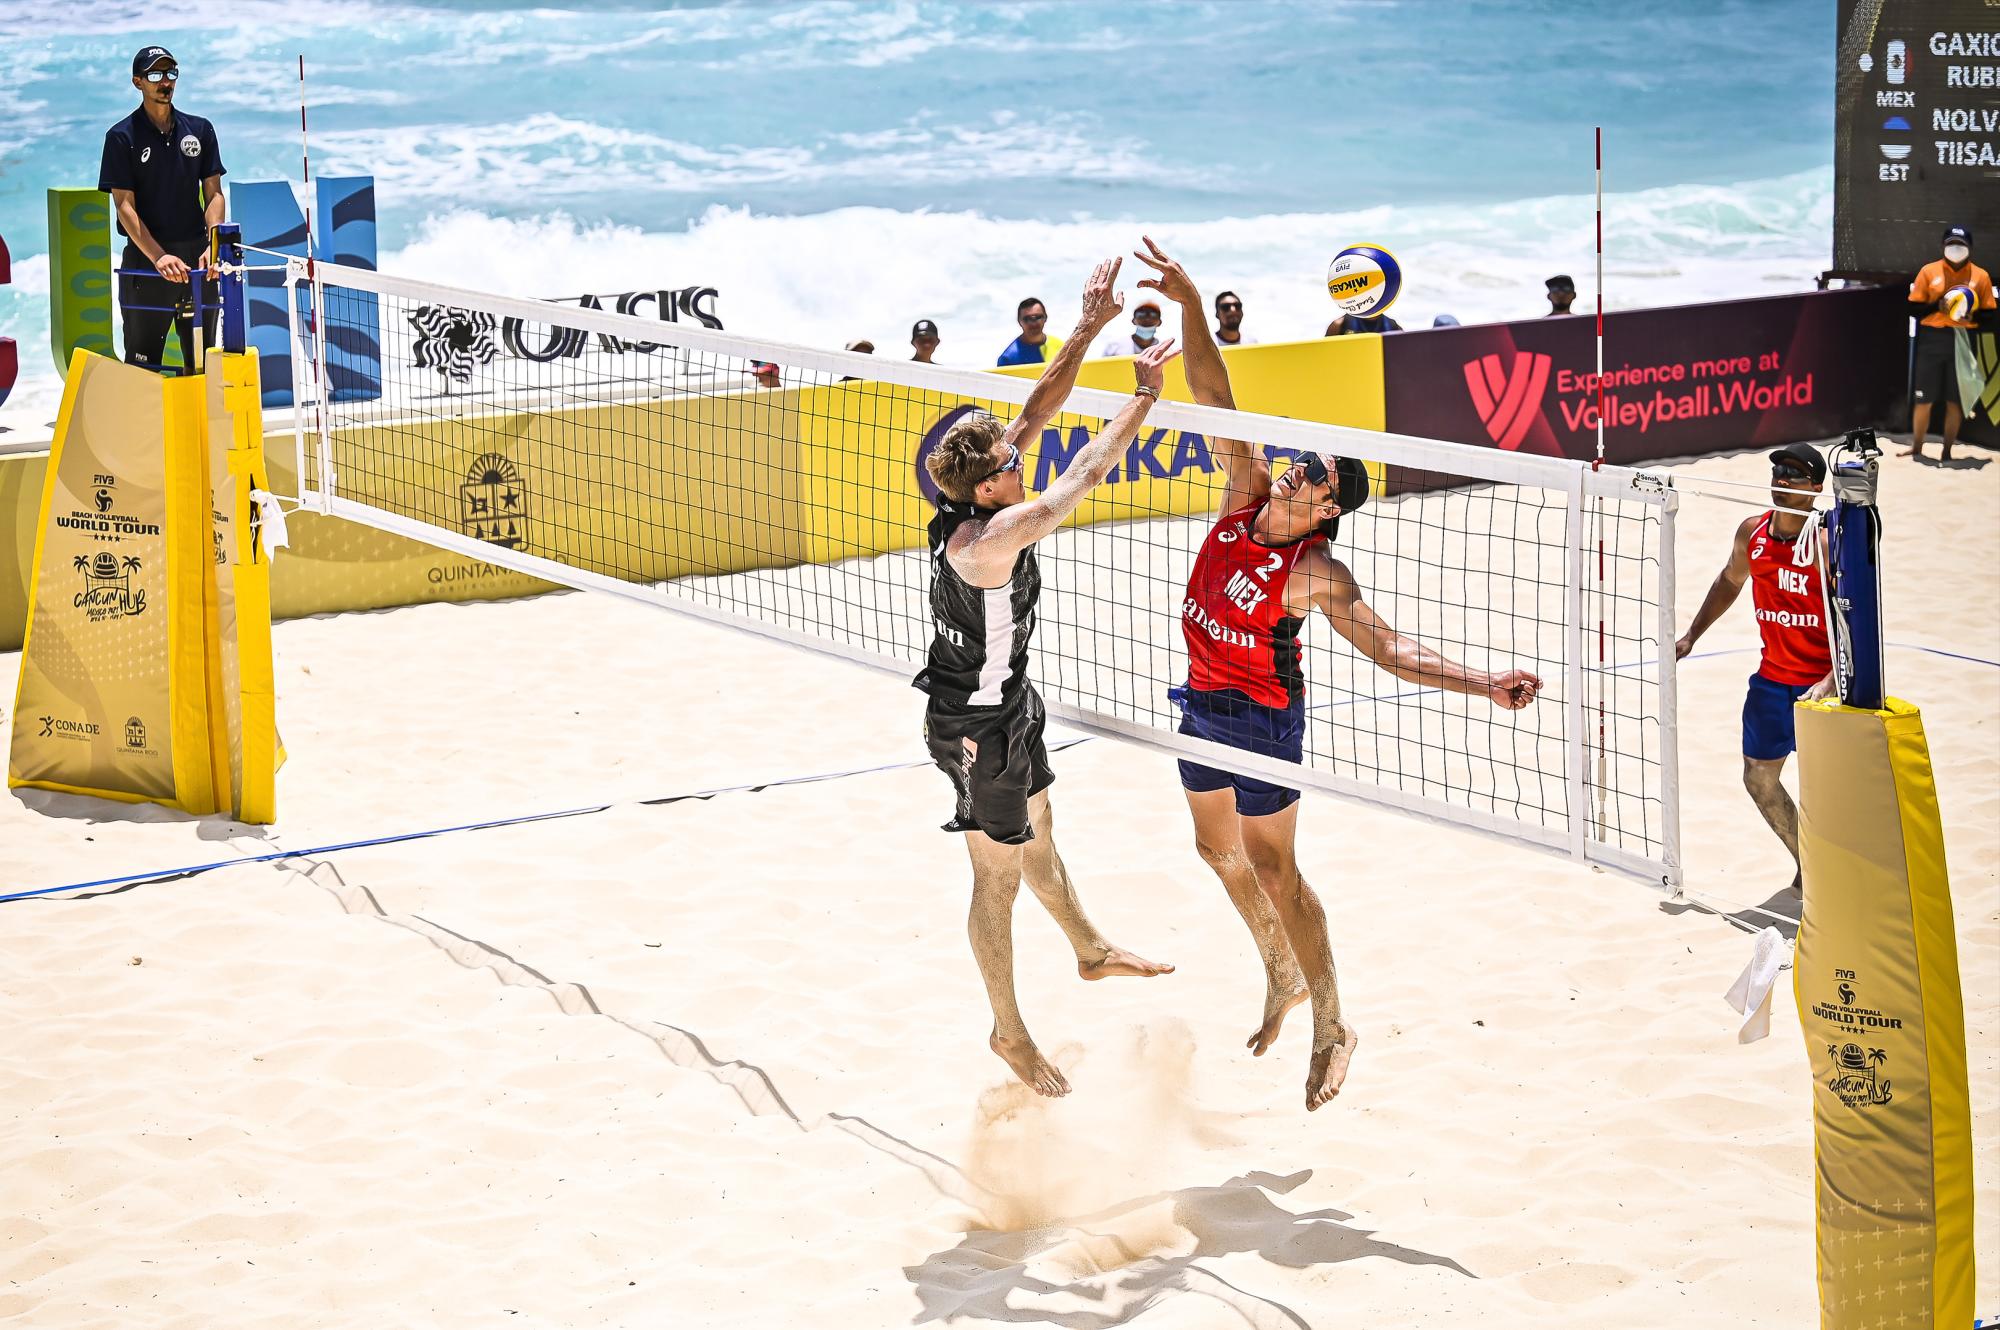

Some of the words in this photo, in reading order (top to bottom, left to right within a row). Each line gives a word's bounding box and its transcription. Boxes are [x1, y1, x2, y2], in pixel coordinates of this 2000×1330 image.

[1876, 90, 1916, 108] MEX
[1932, 108, 2000, 132] NOLV
[1934, 141, 2000, 167] TIISA
[1878, 163, 1910, 182] EST
[1335, 263, 1351, 273] FIVB
[1328, 276, 1368, 294] MIKASA
[1557, 362, 1685, 396] Experience
[1692, 356, 1751, 379] more
[1758, 351, 1780, 371] at
[1559, 373, 1813, 434] Volleyball.World
[94, 474, 115, 485] FIVB
[56, 517, 110, 532] WORLD
[113, 522, 160, 536] TOUR
[71, 511, 92, 519] BEACH
[94, 513, 140, 523] VOLLEYBALL
[428, 563, 521, 584] QUINTAN
[1254, 552, 1284, 583] 2
[1777, 567, 1809, 597] MEX
[1223, 569, 1269, 616] MEX
[55, 719, 100, 735] CONADE
[1834, 968, 1856, 980] FIVB
[1812, 1004, 1854, 1024] WORLD
[1856, 1014, 1903, 1029] TOUR
[1820, 1001, 1838, 1011] BEACH
[1839, 1005, 1882, 1016] VOLLEYBALL
